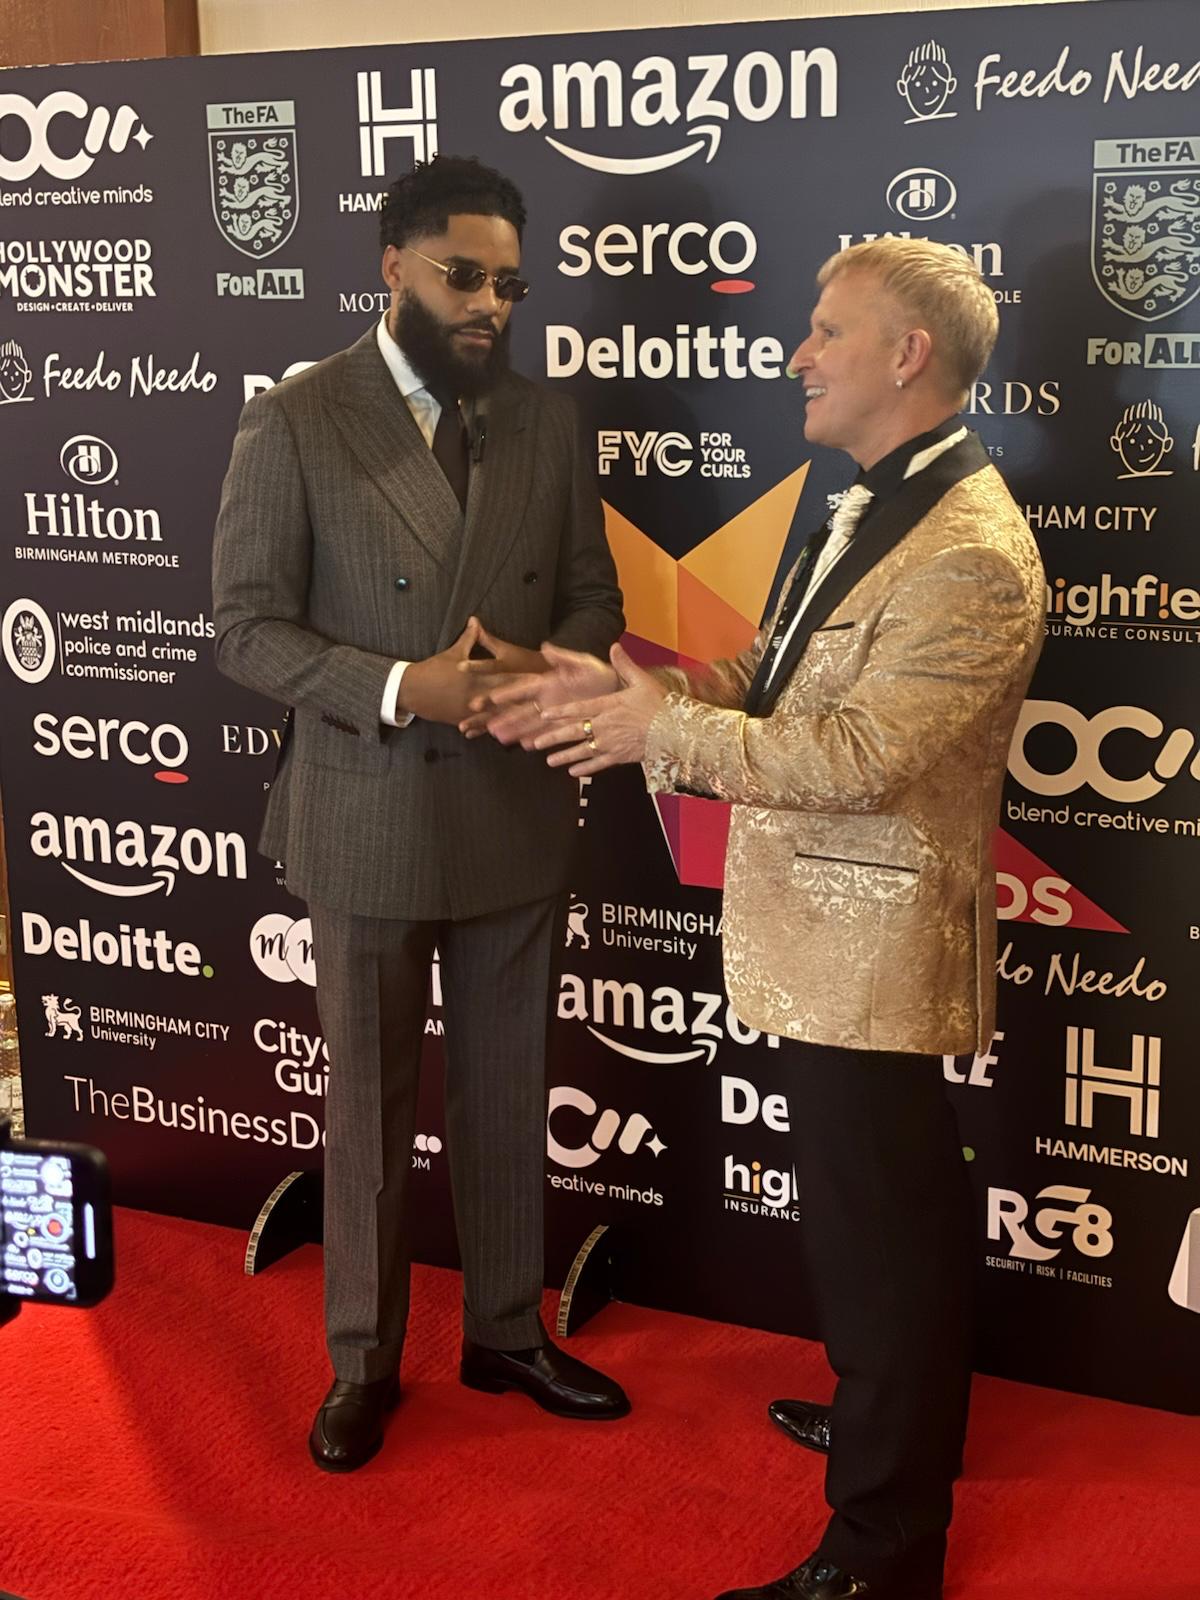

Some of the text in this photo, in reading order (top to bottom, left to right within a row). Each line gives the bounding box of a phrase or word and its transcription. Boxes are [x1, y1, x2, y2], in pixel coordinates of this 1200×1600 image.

[499, 47, 838, 132] amazon
[974, 45, 1092, 111] Feedo
[35, 186, 101, 205] creative
[103, 184, 153, 204] minds
[557, 220, 758, 277] serco
[43, 351, 121, 398] Feedo
[129, 351, 218, 398] Needo
[597, 430, 693, 477] FYC
[700, 432, 732, 446] FOR
[700, 448, 746, 462] YOUR
[700, 464, 752, 479] CURLS
[24, 493, 163, 541] Hilton
[1095, 507, 1157, 532] CITY
[15, 547, 180, 568] BIRMINGHAM METROPOLE
[61, 610, 216, 638] west midlands
[65, 636, 197, 662] police and crime
[66, 662, 176, 684] commissioner
[32, 712, 189, 767] serco
[1007, 800, 1069, 825] blend
[1074, 811, 1170, 833] creative
[30, 811, 248, 879] amazon
[22, 912, 214, 978] Deloitte.
[602, 928, 697, 960] University
[1044, 953, 1168, 1002] Needo
[90, 1006, 230, 1041] BIRMINGHAM CITY
[91, 1025, 157, 1050] University
[1035, 1136, 1188, 1177] HAMMERSON
[609, 1184, 664, 1206] minds
[987, 1184, 1114, 1262] RG8
[986, 1255, 1113, 1288] SECURITY RISK FACILITIES
